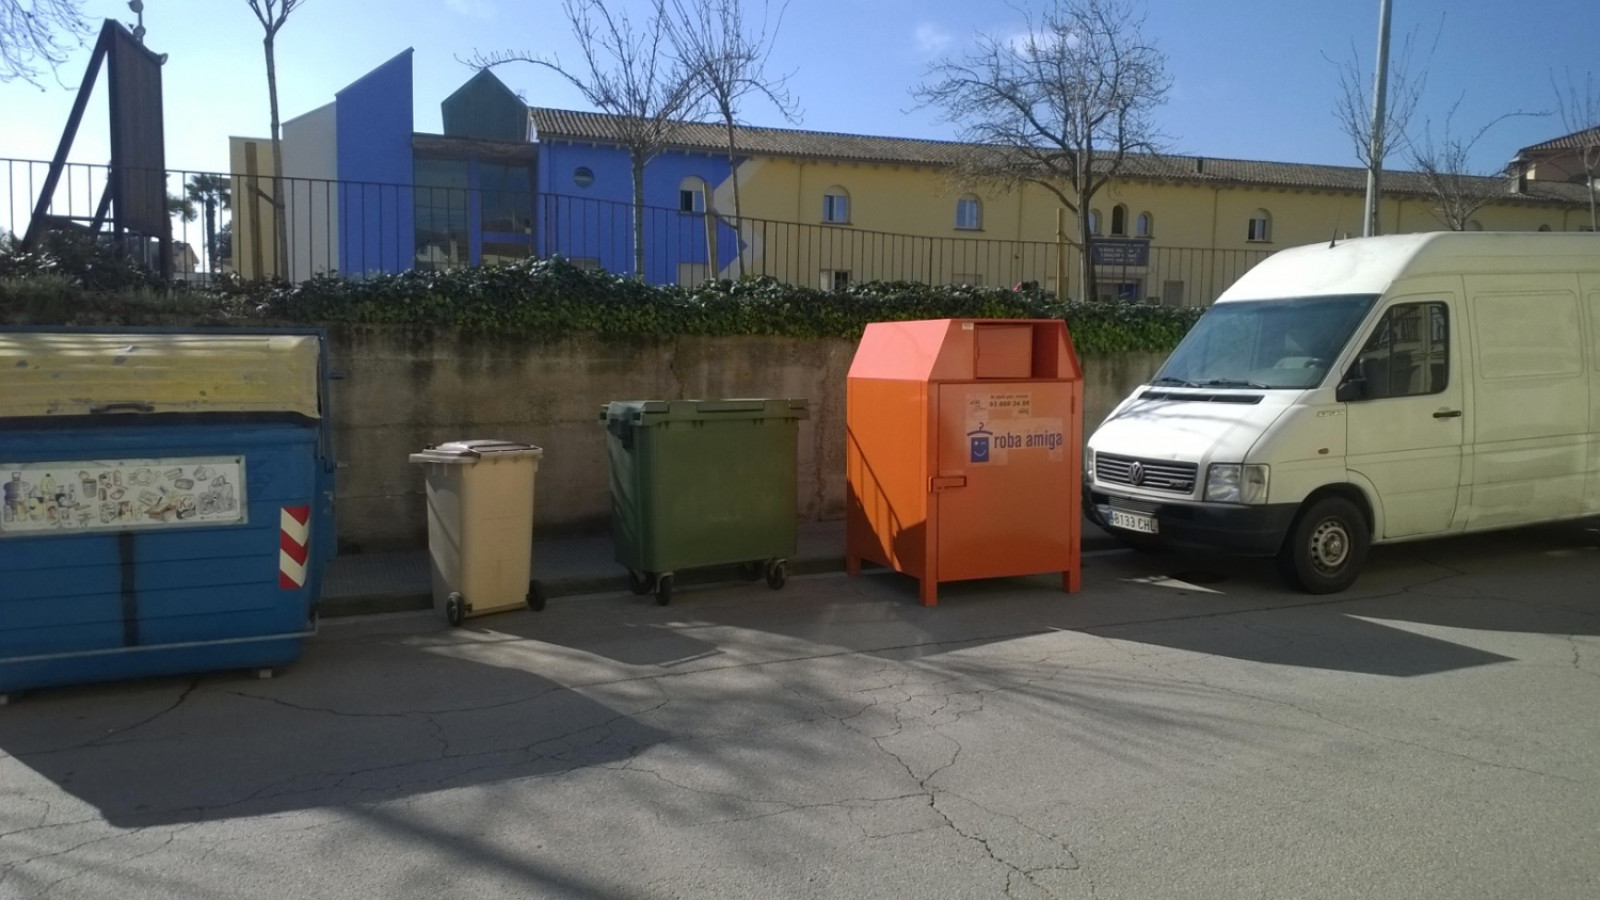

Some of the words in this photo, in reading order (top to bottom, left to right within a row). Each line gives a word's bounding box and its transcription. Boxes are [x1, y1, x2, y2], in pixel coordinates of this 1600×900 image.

[994, 432, 1022, 449] roba
[1026, 430, 1063, 450] amiga
[1114, 513, 1135, 528] 8133
[1138, 518, 1156, 532] CHL
